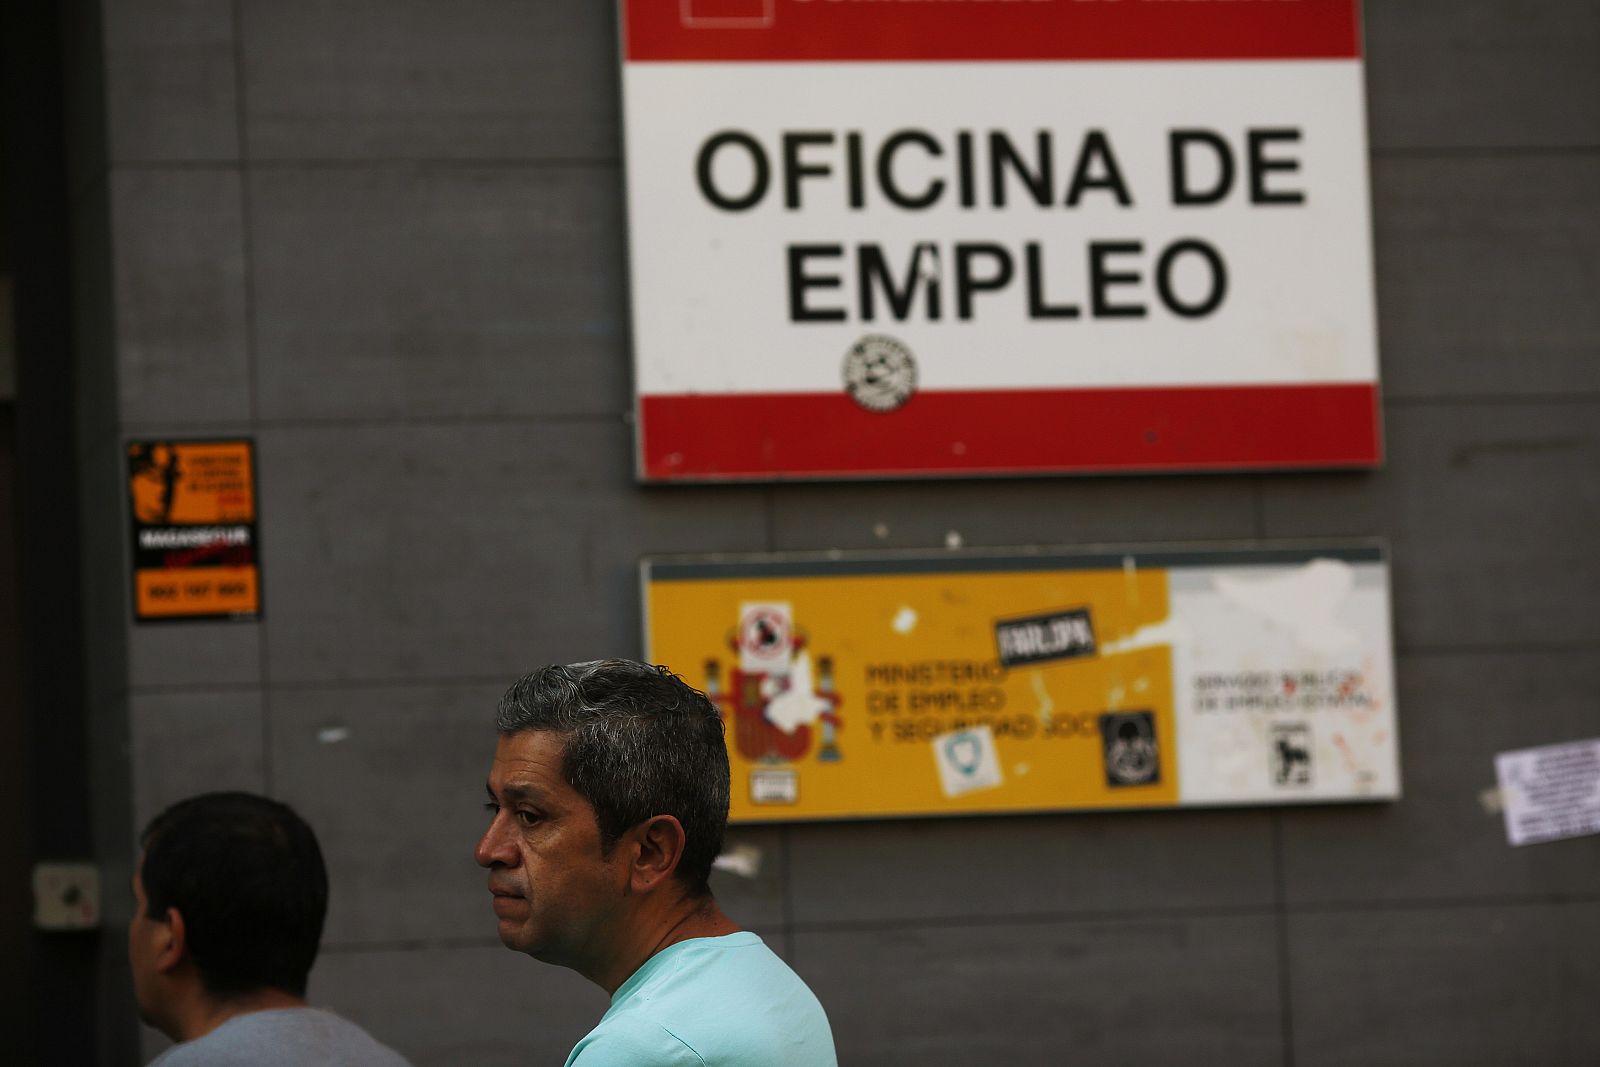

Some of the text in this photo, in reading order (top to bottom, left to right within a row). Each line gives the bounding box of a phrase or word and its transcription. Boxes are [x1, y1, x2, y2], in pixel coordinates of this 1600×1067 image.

[695, 127, 1307, 213] OFICINA DE
[786, 237, 1230, 323] EMPLEO
[865, 661, 1008, 684] MINISTERIO
[866, 688, 1006, 713] DE EMPLEO
[868, 721, 885, 742] Y
[1044, 713, 1099, 739] SOC
